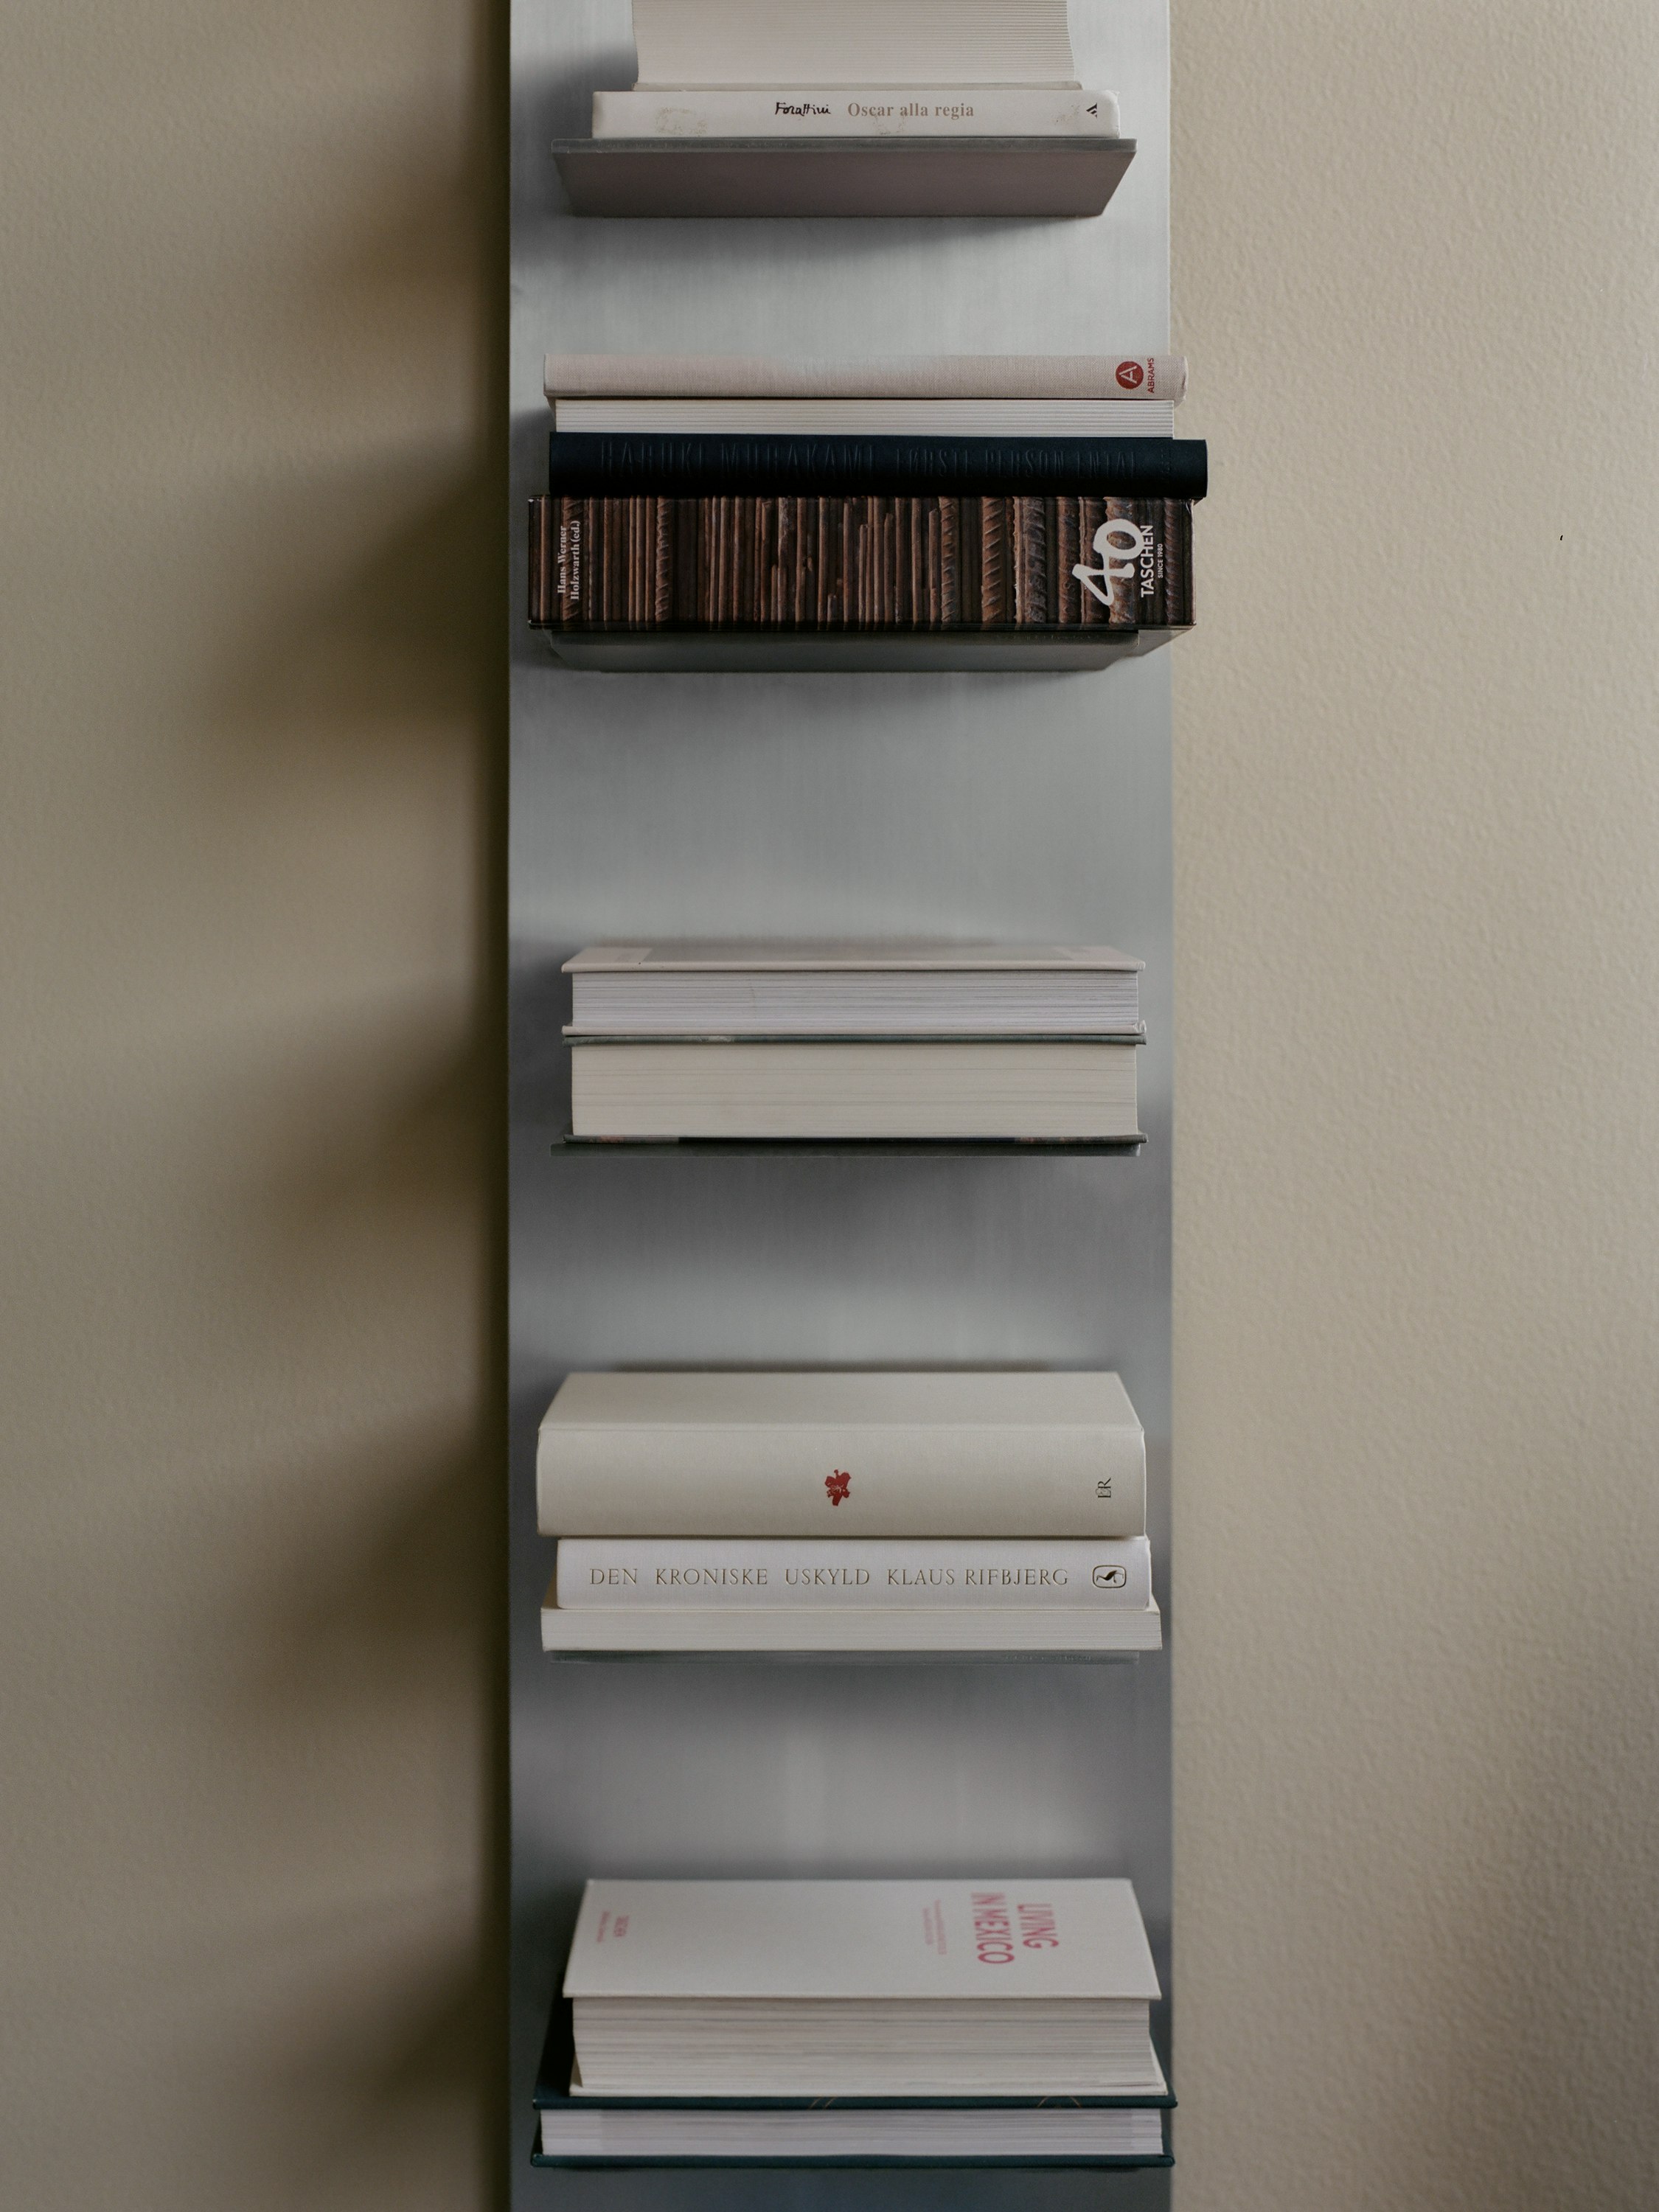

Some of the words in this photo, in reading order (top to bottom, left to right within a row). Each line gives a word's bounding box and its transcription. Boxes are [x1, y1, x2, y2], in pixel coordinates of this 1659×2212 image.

[847, 102, 894, 117] Oscar
[900, 102, 928, 117] alla
[934, 102, 975, 121] regia
[1147, 357, 1155, 394] ABRAMS
[557, 526, 567, 564] Werner
[570, 520, 581, 543] (ed.)
[557, 566, 566, 594] Hans
[570, 544, 580, 600] Holzwarth
[1072, 518, 1144, 606] 40
[1141, 525, 1154, 598] TASCHEN
[589, 1568, 638, 1585] DEN
[655, 1568, 768, 1585] KRONISKE
[785, 1568, 870, 1585] USKYLD
[887, 1568, 956, 1585] KLAUS
[964, 1568, 1069, 1585] RIFBJERG
[970, 1891, 1006, 1906] IN
[972, 1908, 1016, 1964] MEXICO
[1017, 1903, 1060, 1950] LIVING
